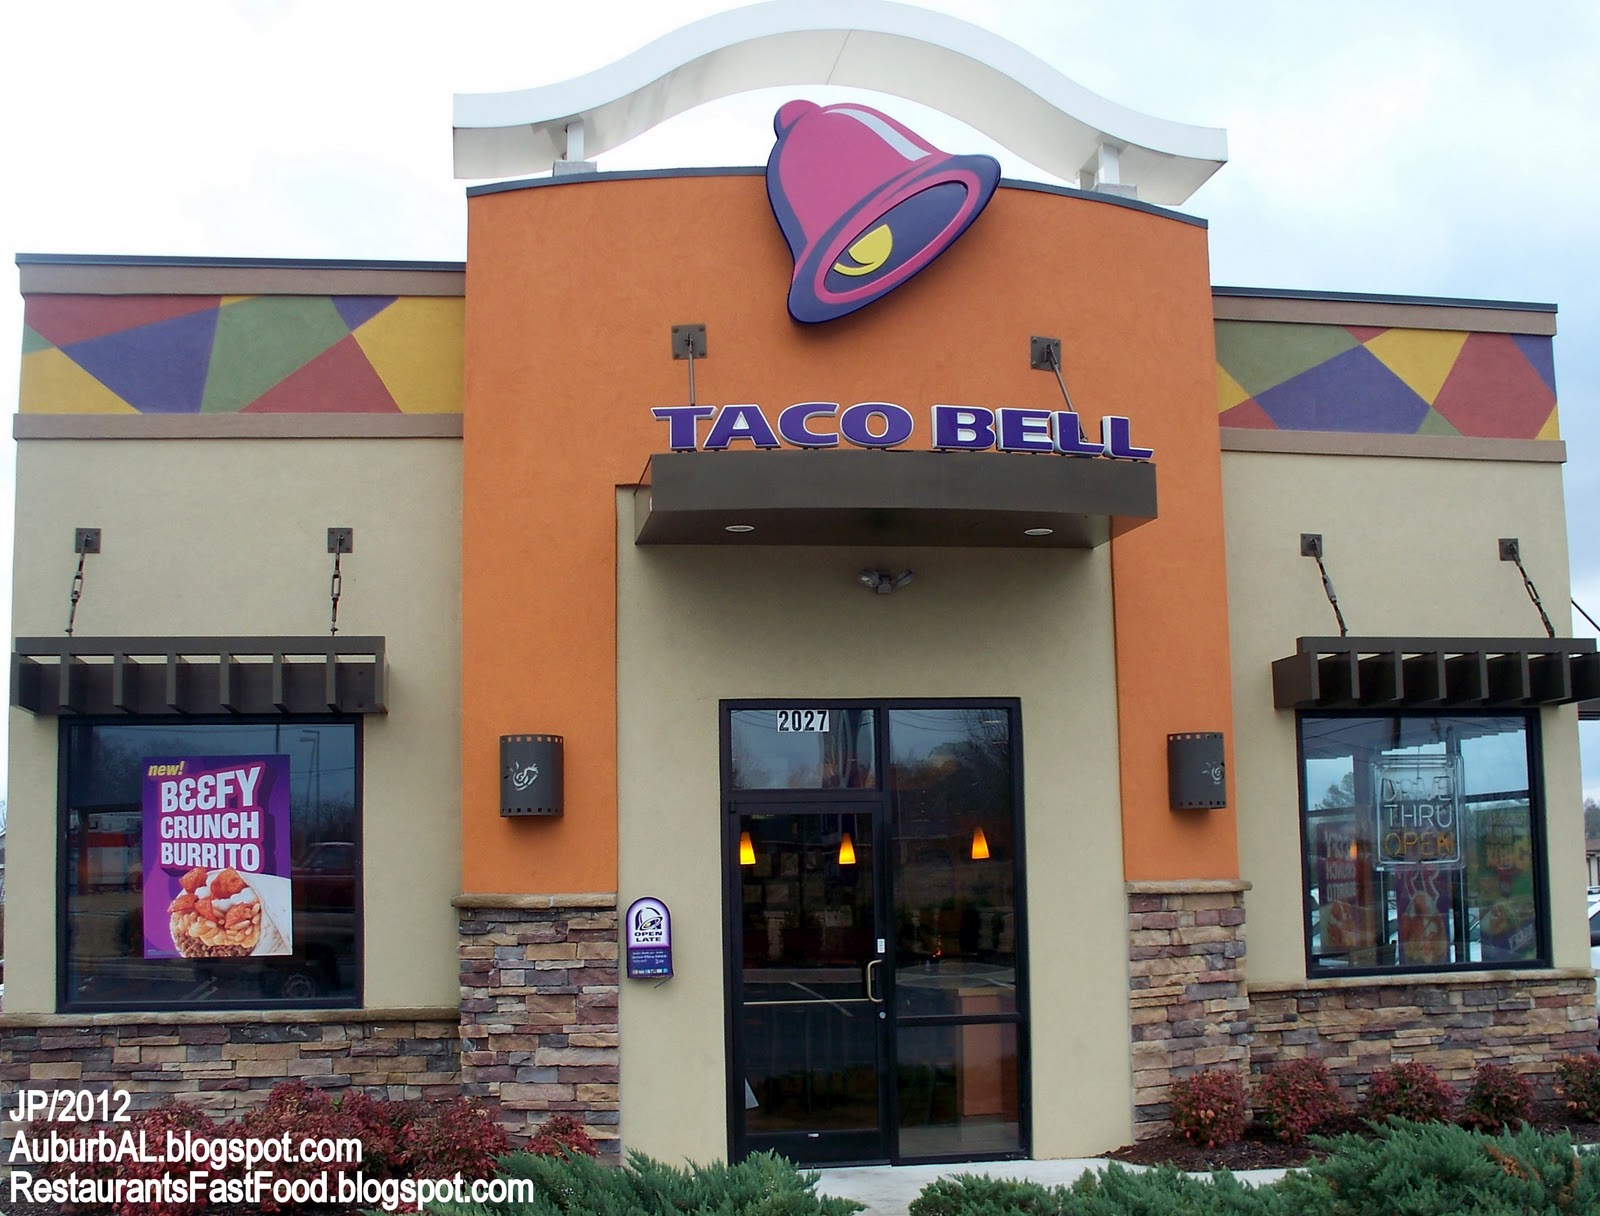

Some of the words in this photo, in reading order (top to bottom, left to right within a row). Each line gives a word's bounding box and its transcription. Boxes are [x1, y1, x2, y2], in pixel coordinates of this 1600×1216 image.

[650, 402, 914, 449] TACO
[930, 404, 1154, 460] BELL
[778, 710, 827, 731] 2027
[148, 760, 185, 776] new!
[161, 766, 261, 812] BEEFY
[160, 811, 260, 839] CRUNCH
[1383, 804, 1452, 828] THRU
[161, 842, 260, 872] BURRITO
[1385, 831, 1454, 857] OPEN
